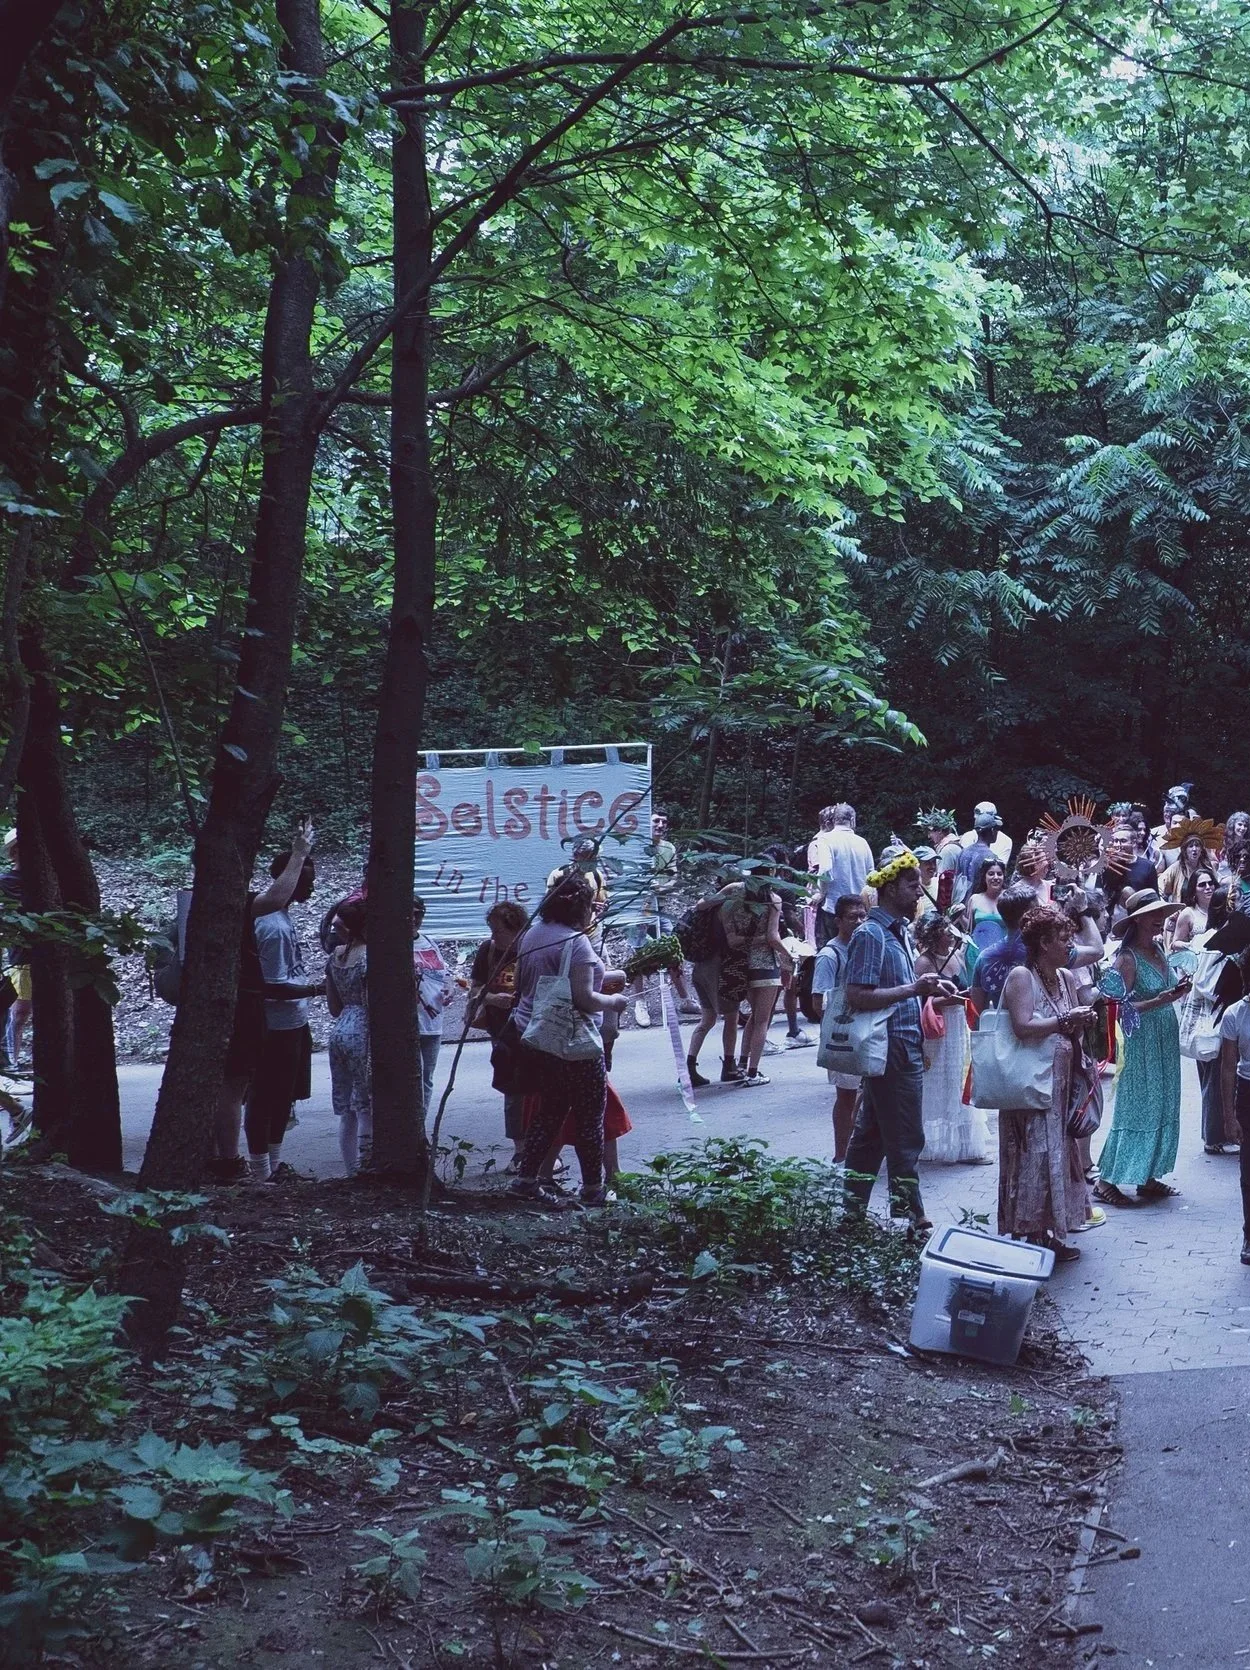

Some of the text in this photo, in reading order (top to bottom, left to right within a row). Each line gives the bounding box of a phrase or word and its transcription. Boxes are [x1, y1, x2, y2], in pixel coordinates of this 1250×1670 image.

[416, 775, 643, 841] Solstice
[431, 860, 532, 904] in the
